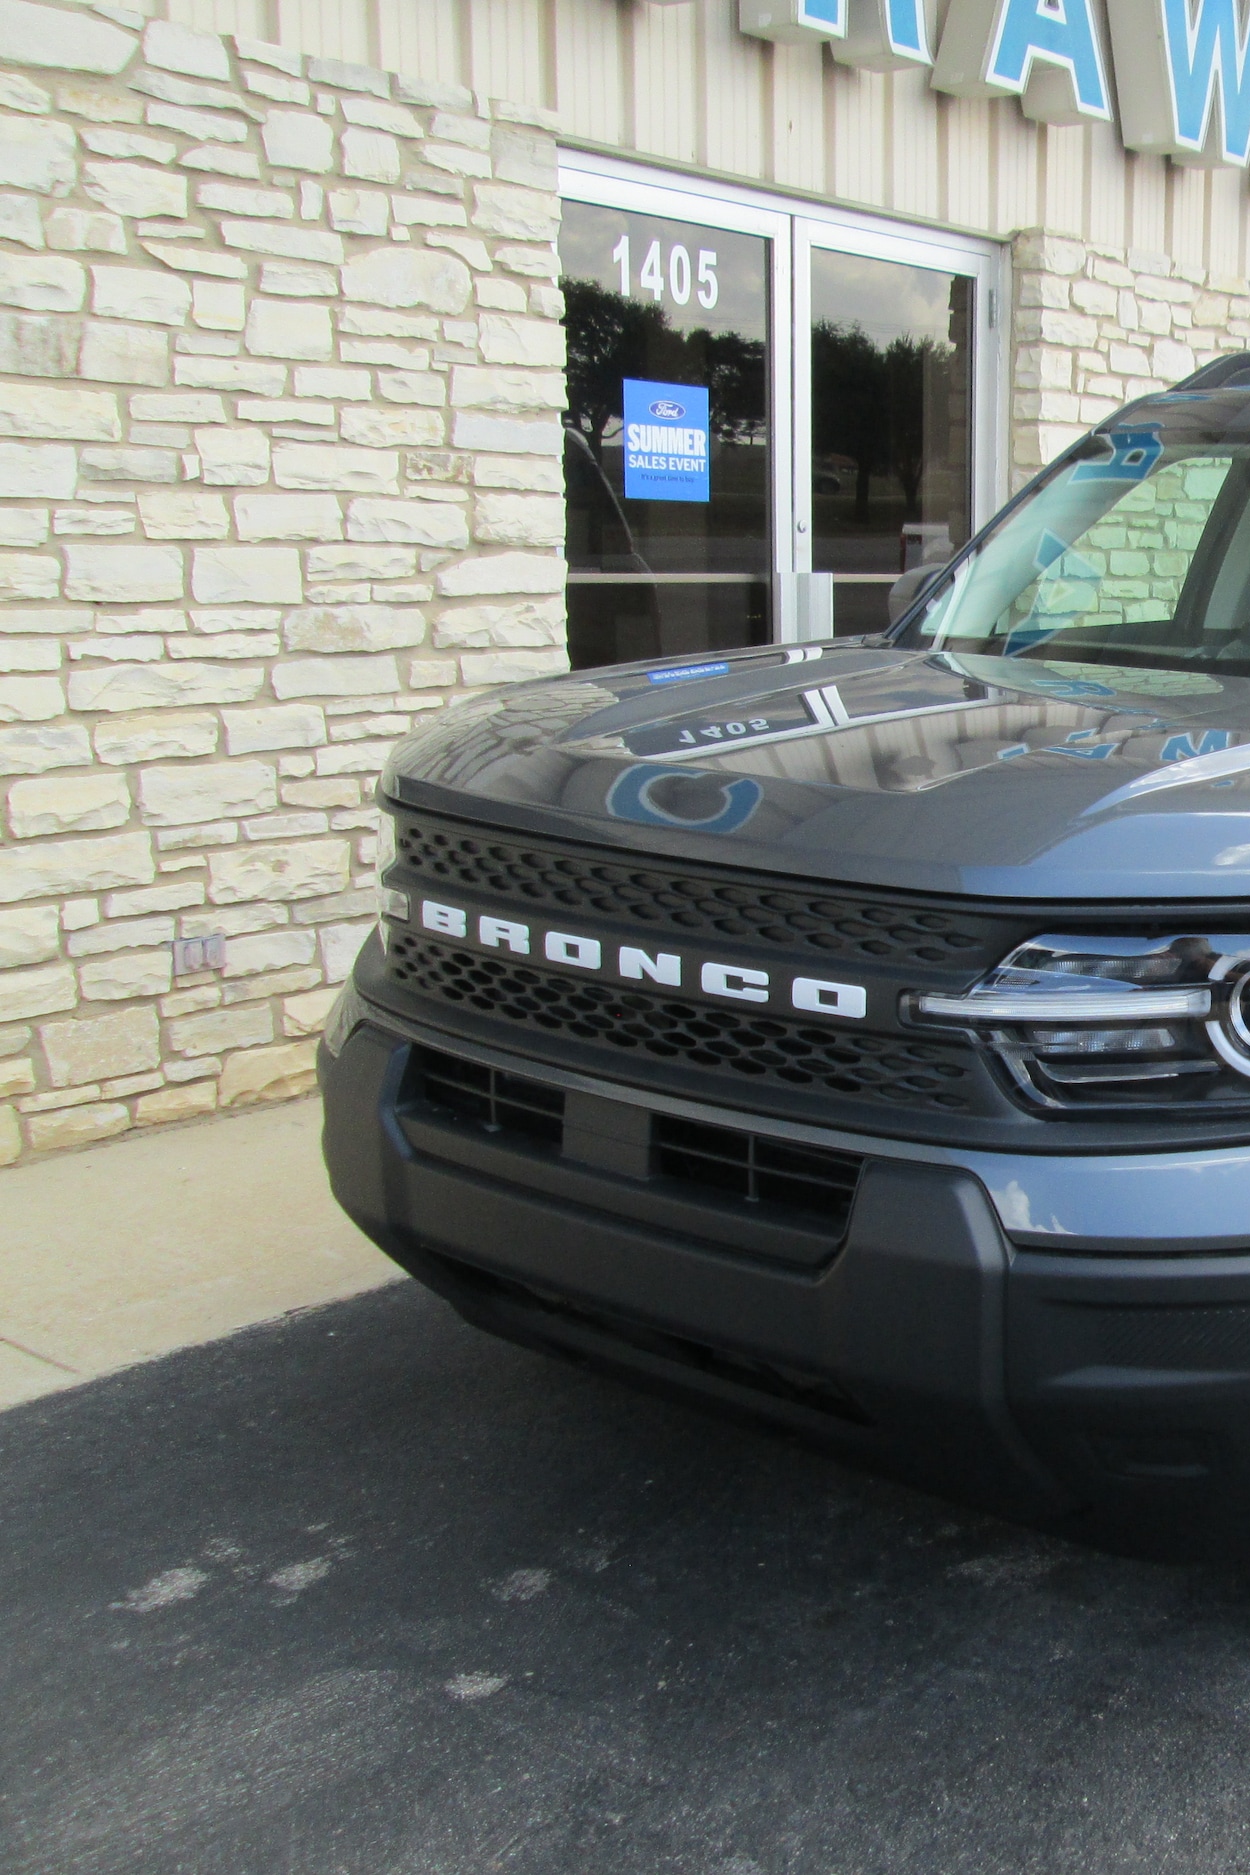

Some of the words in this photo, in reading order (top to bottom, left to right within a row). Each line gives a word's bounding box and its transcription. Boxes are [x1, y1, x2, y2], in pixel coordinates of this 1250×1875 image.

[613, 235, 718, 310] 1405
[627, 423, 706, 457] SUMMER
[628, 454, 667, 470] SALES
[669, 457, 706, 473] EVENT
[422, 900, 867, 1019] BRONCO
